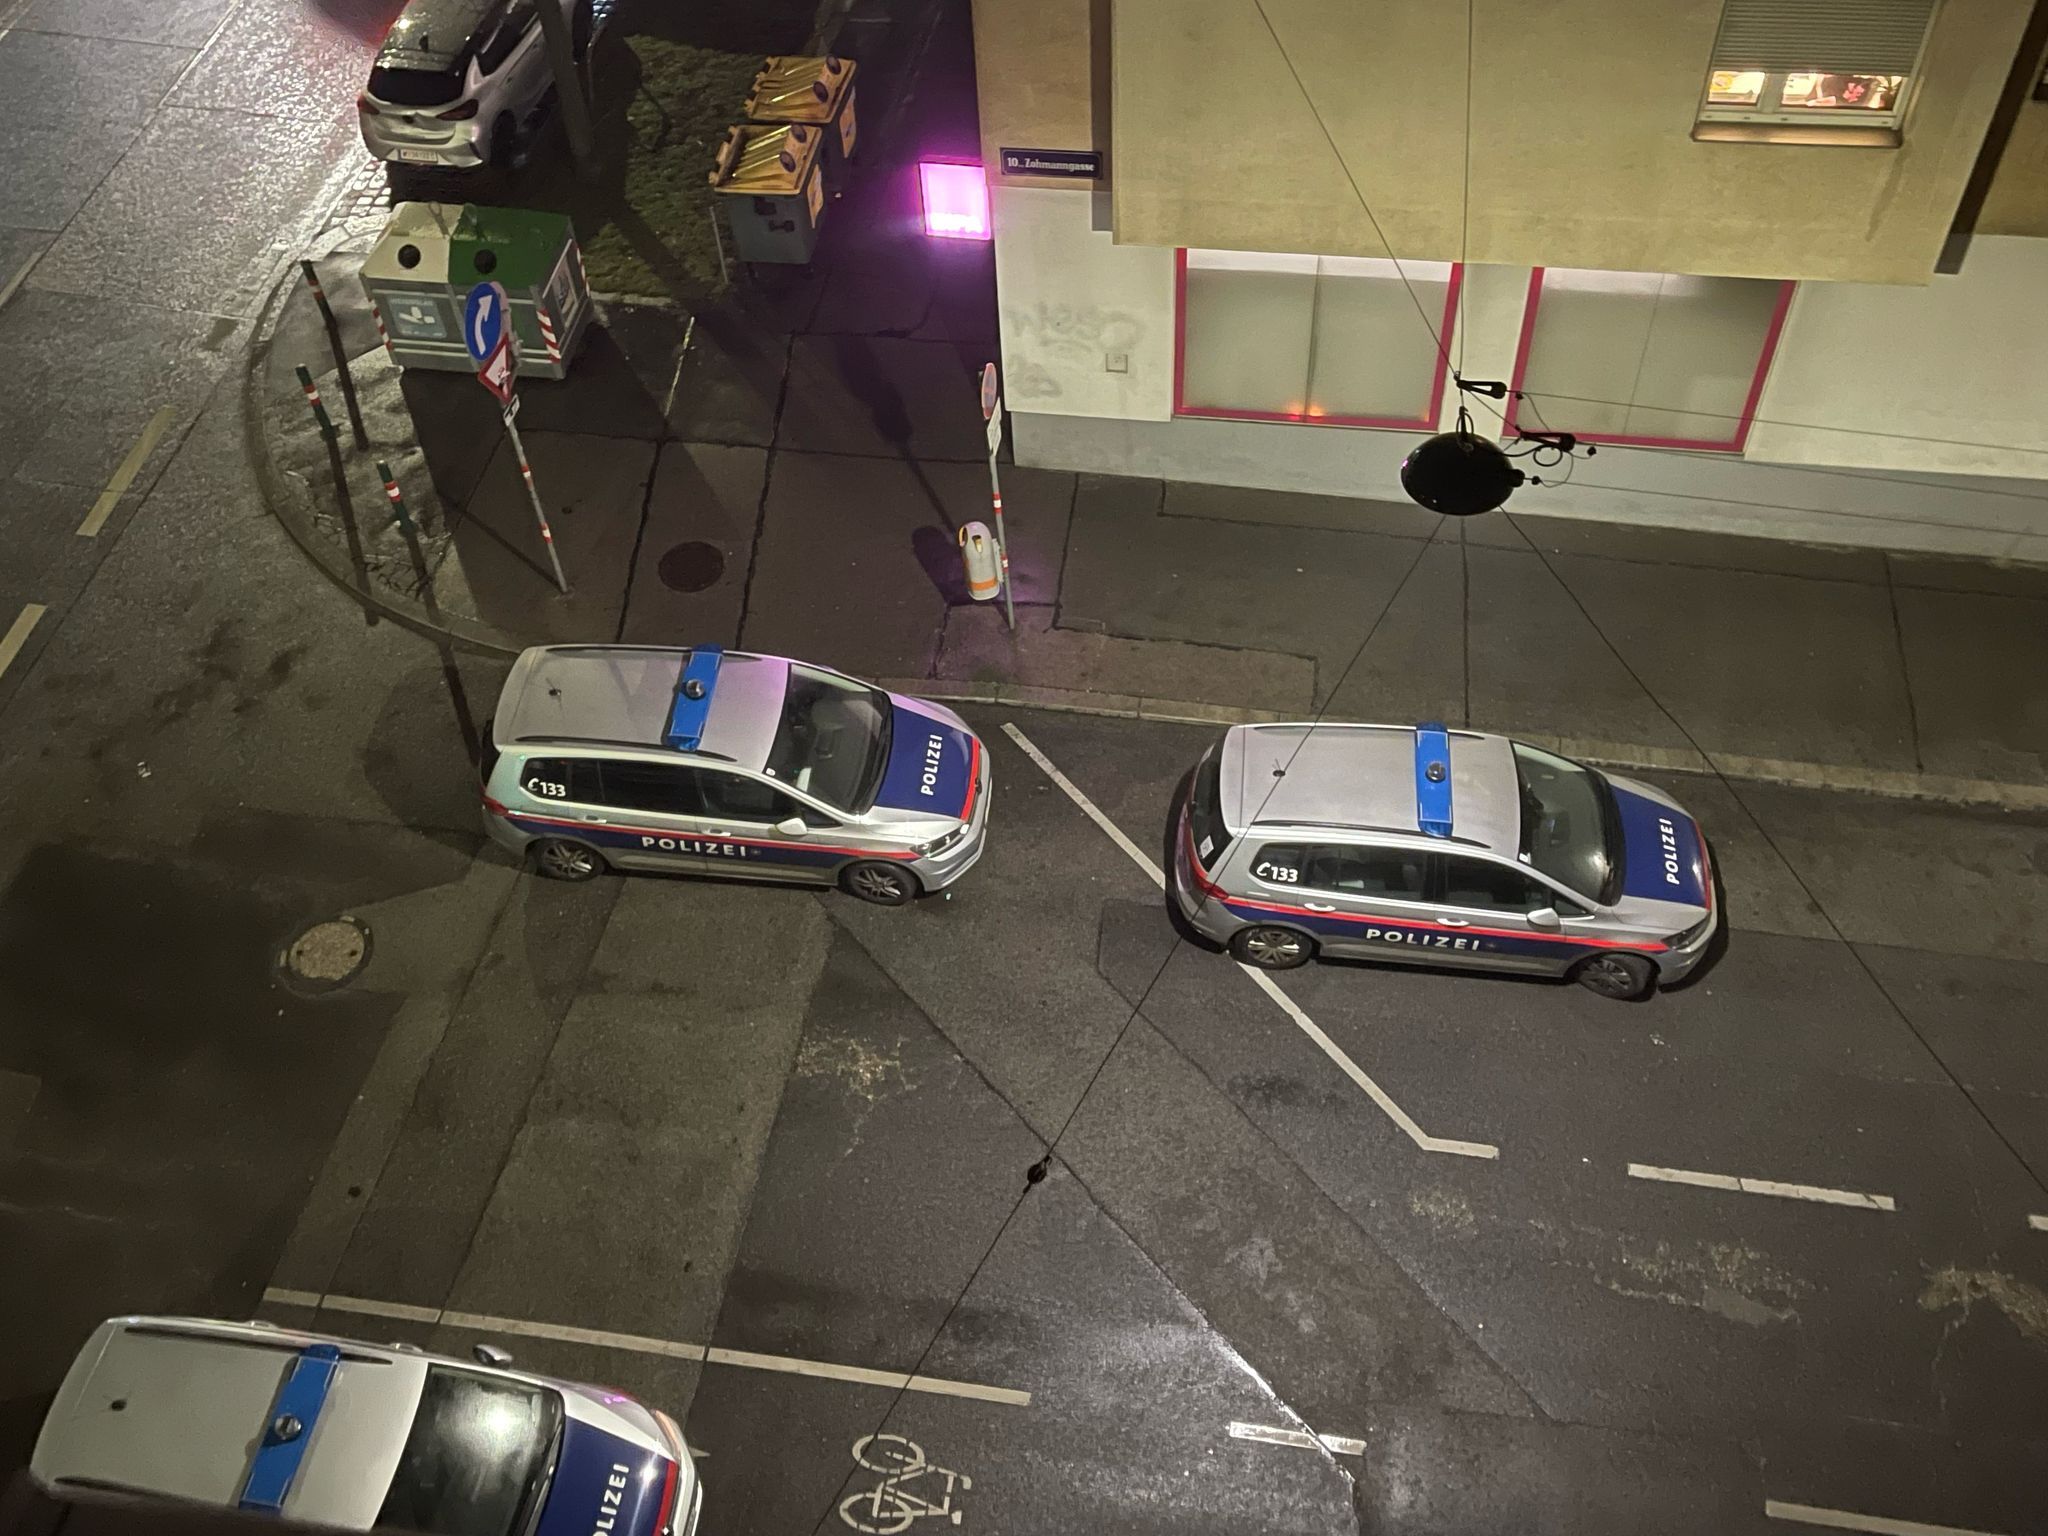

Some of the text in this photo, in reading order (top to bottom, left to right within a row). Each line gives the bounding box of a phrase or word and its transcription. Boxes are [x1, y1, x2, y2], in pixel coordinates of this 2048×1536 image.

[1025, 158, 1095, 172] Zohmanngasse
[920, 734, 943, 796] POLIZEI
[641, 836, 746, 857] POLIZEI
[1658, 818, 1680, 885] POLIZEI
[1366, 928, 1479, 951] POLIZEI
